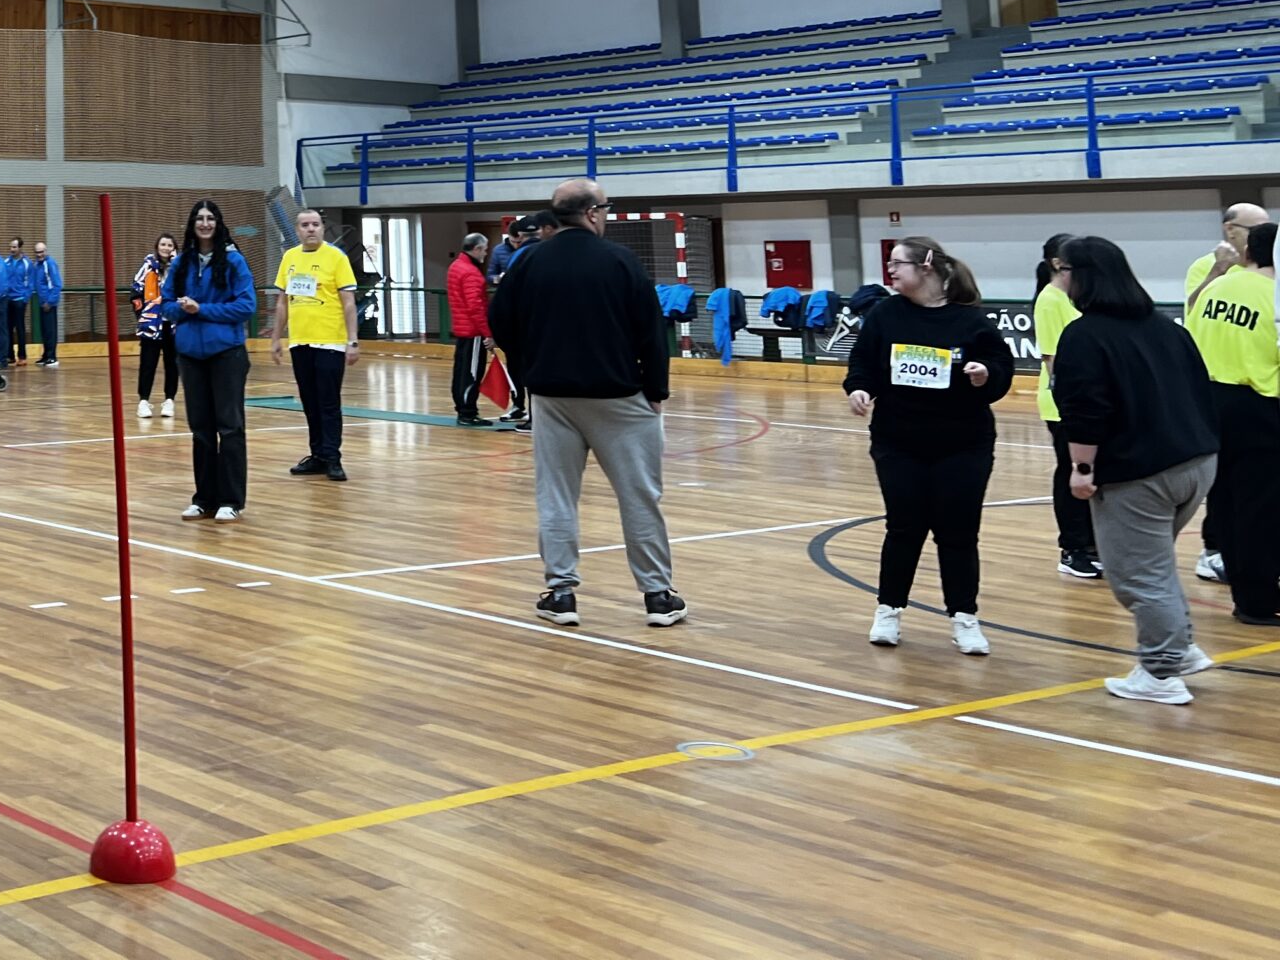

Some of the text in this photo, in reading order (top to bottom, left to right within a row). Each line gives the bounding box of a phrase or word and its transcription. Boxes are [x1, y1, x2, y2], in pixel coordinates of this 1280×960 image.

[292, 282, 311, 290] 2014
[1202, 298, 1259, 331] APADI
[900, 362, 938, 378] 2004
